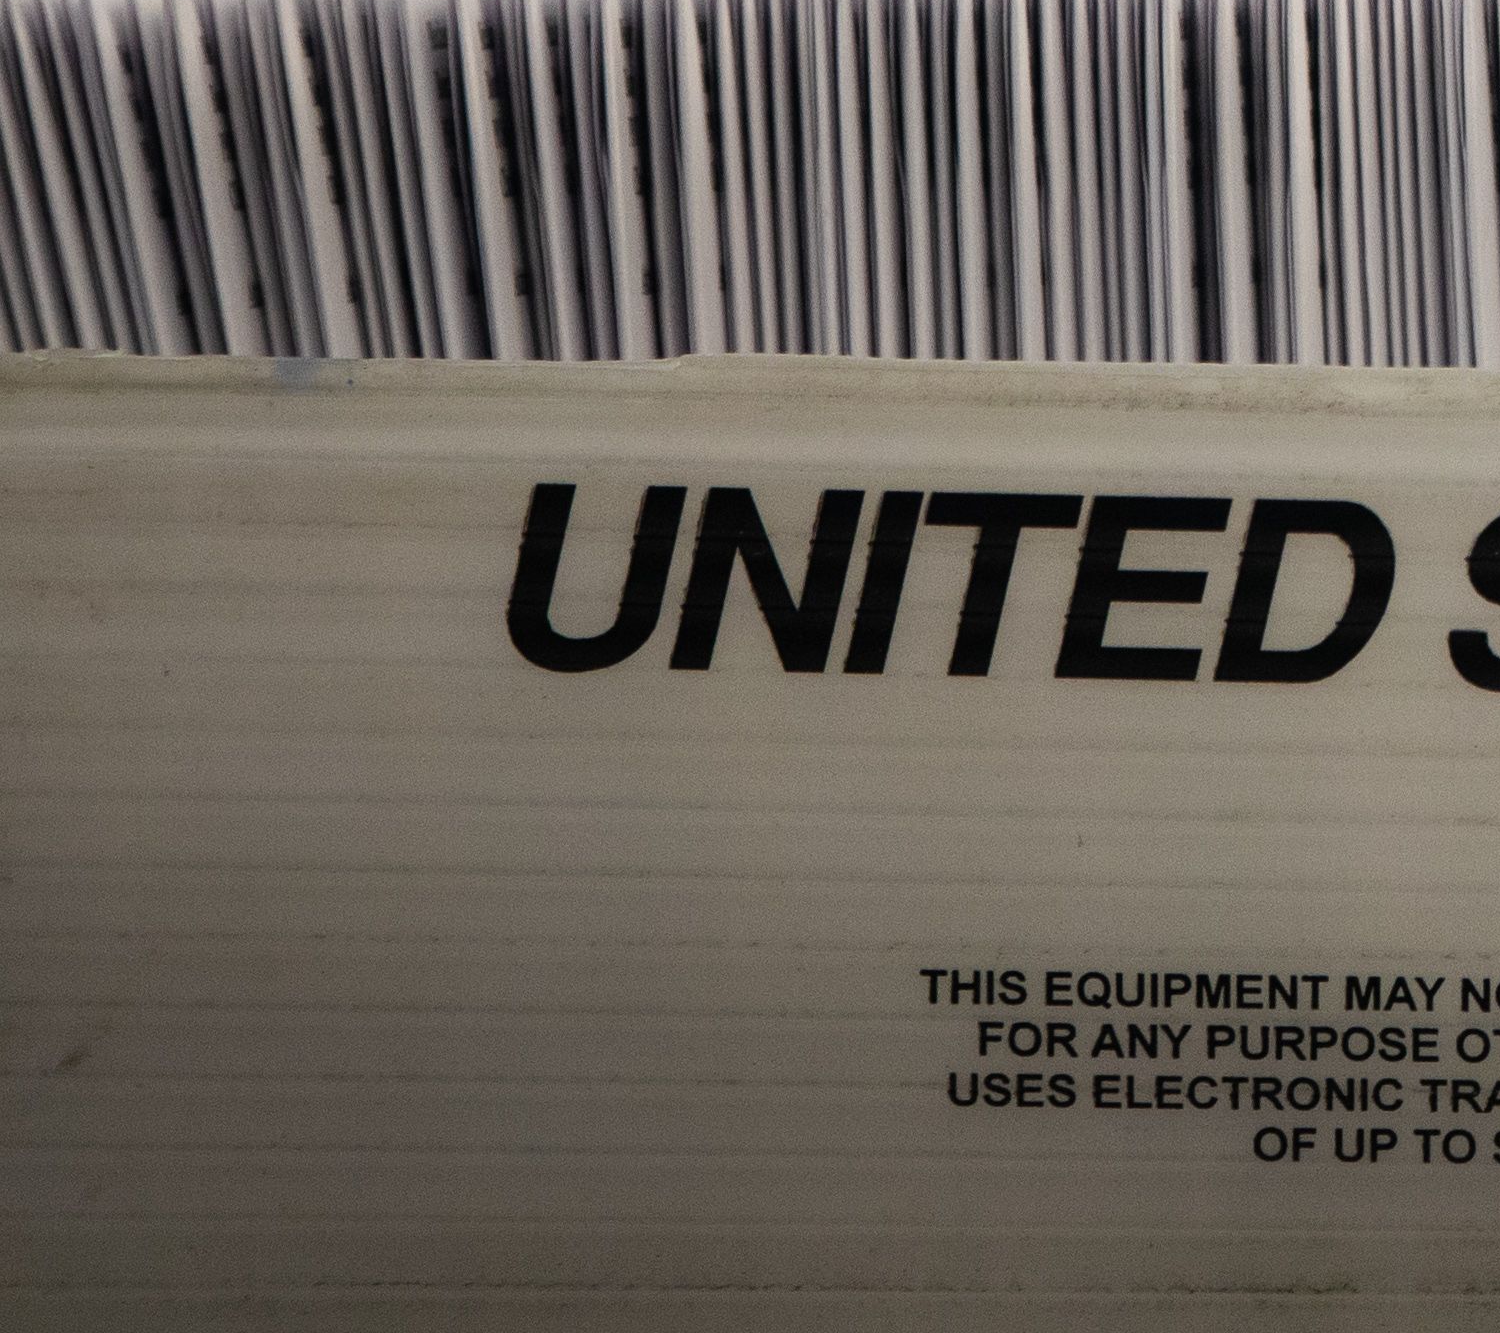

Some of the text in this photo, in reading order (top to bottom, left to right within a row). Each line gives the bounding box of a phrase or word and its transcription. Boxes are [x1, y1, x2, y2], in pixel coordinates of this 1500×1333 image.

[505, 482, 1397, 684] UNITED
[919, 968, 1028, 1006] THIS
[1044, 970, 1330, 1011] EQUIPMENT
[1344, 975, 1446, 1012] MAY
[977, 1020, 1079, 1058] FOR
[1090, 1023, 1192, 1060] ANY
[1206, 1024, 1440, 1063] PURPOSE
[947, 1071, 1077, 1109] USES
[1092, 1074, 1404, 1112] ELECTRONIC
[1253, 1126, 1317, 1163] OF
[1333, 1127, 1399, 1164] UP
[1413, 1128, 1478, 1166] TO
